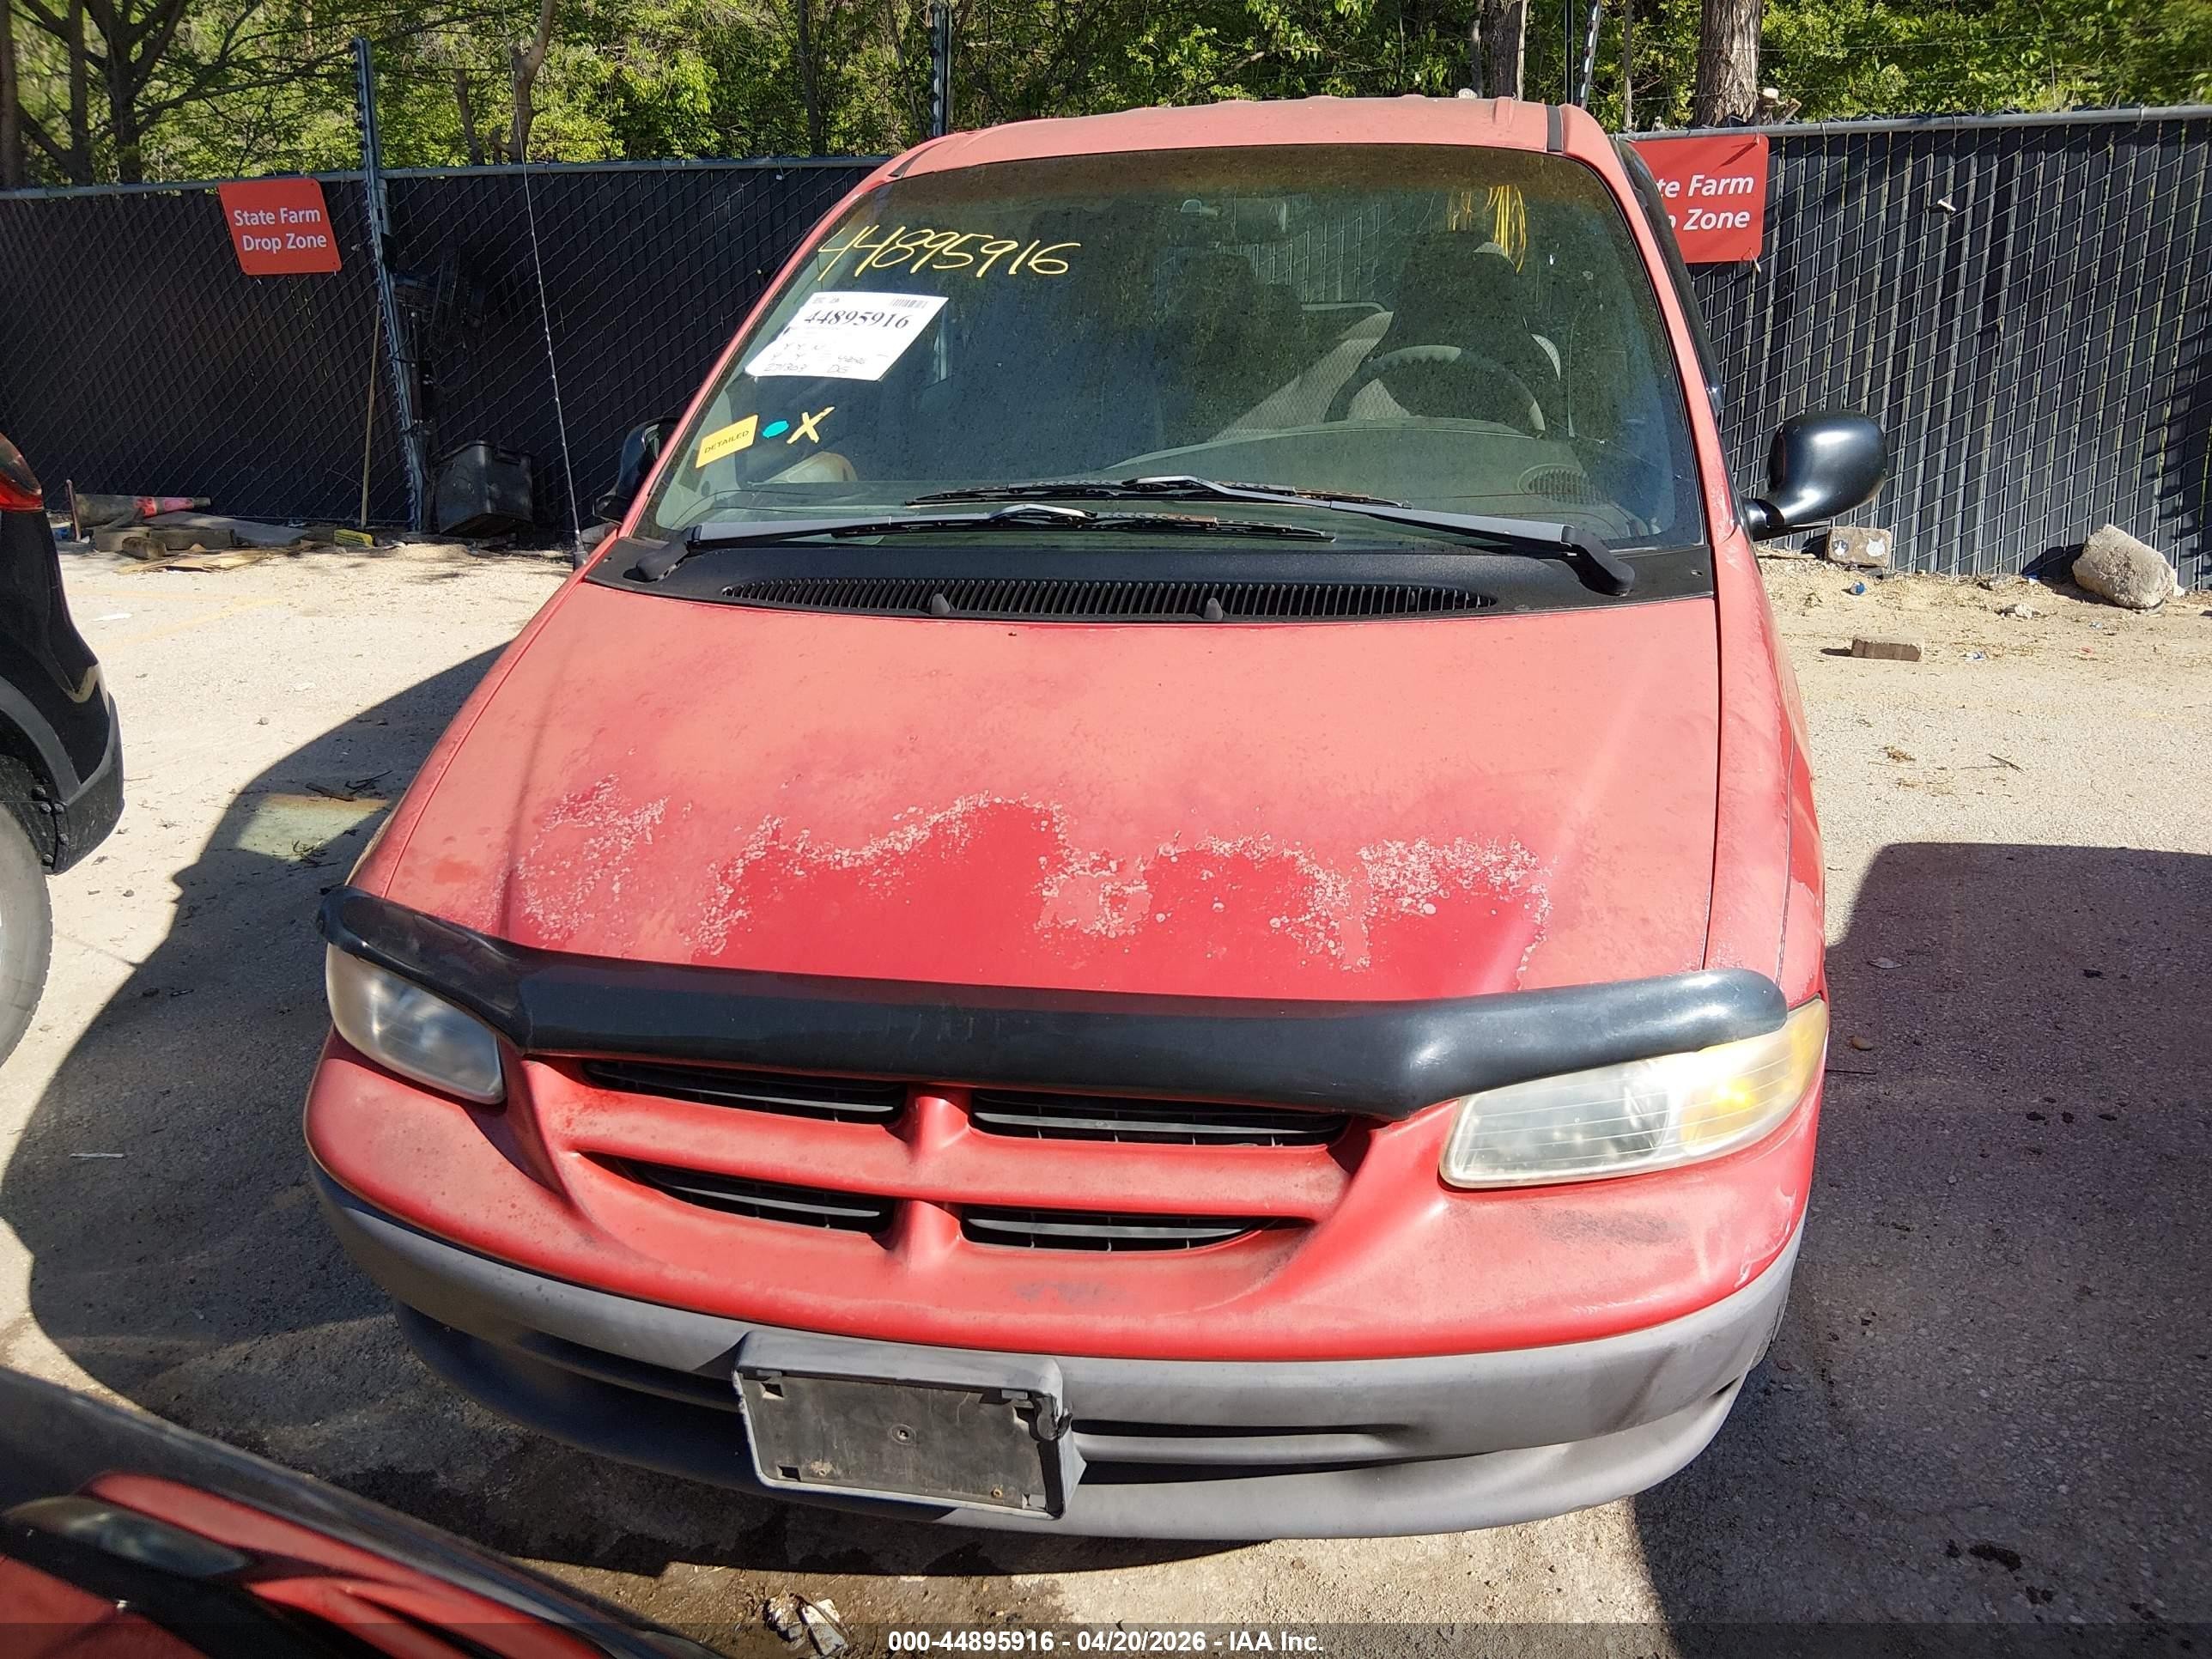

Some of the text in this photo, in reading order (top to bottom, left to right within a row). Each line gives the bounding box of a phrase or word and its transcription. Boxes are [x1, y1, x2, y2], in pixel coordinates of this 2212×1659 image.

[1687, 174, 1754, 198] Farm
[234, 207, 320, 227] State Farm
[1683, 208, 1751, 231] Zone
[242, 233, 327, 254] Drop Zone
[817, 224, 1082, 282] 44895916
[804, 309, 912, 329] 44895916
[704, 430, 750, 454] DETAILED
